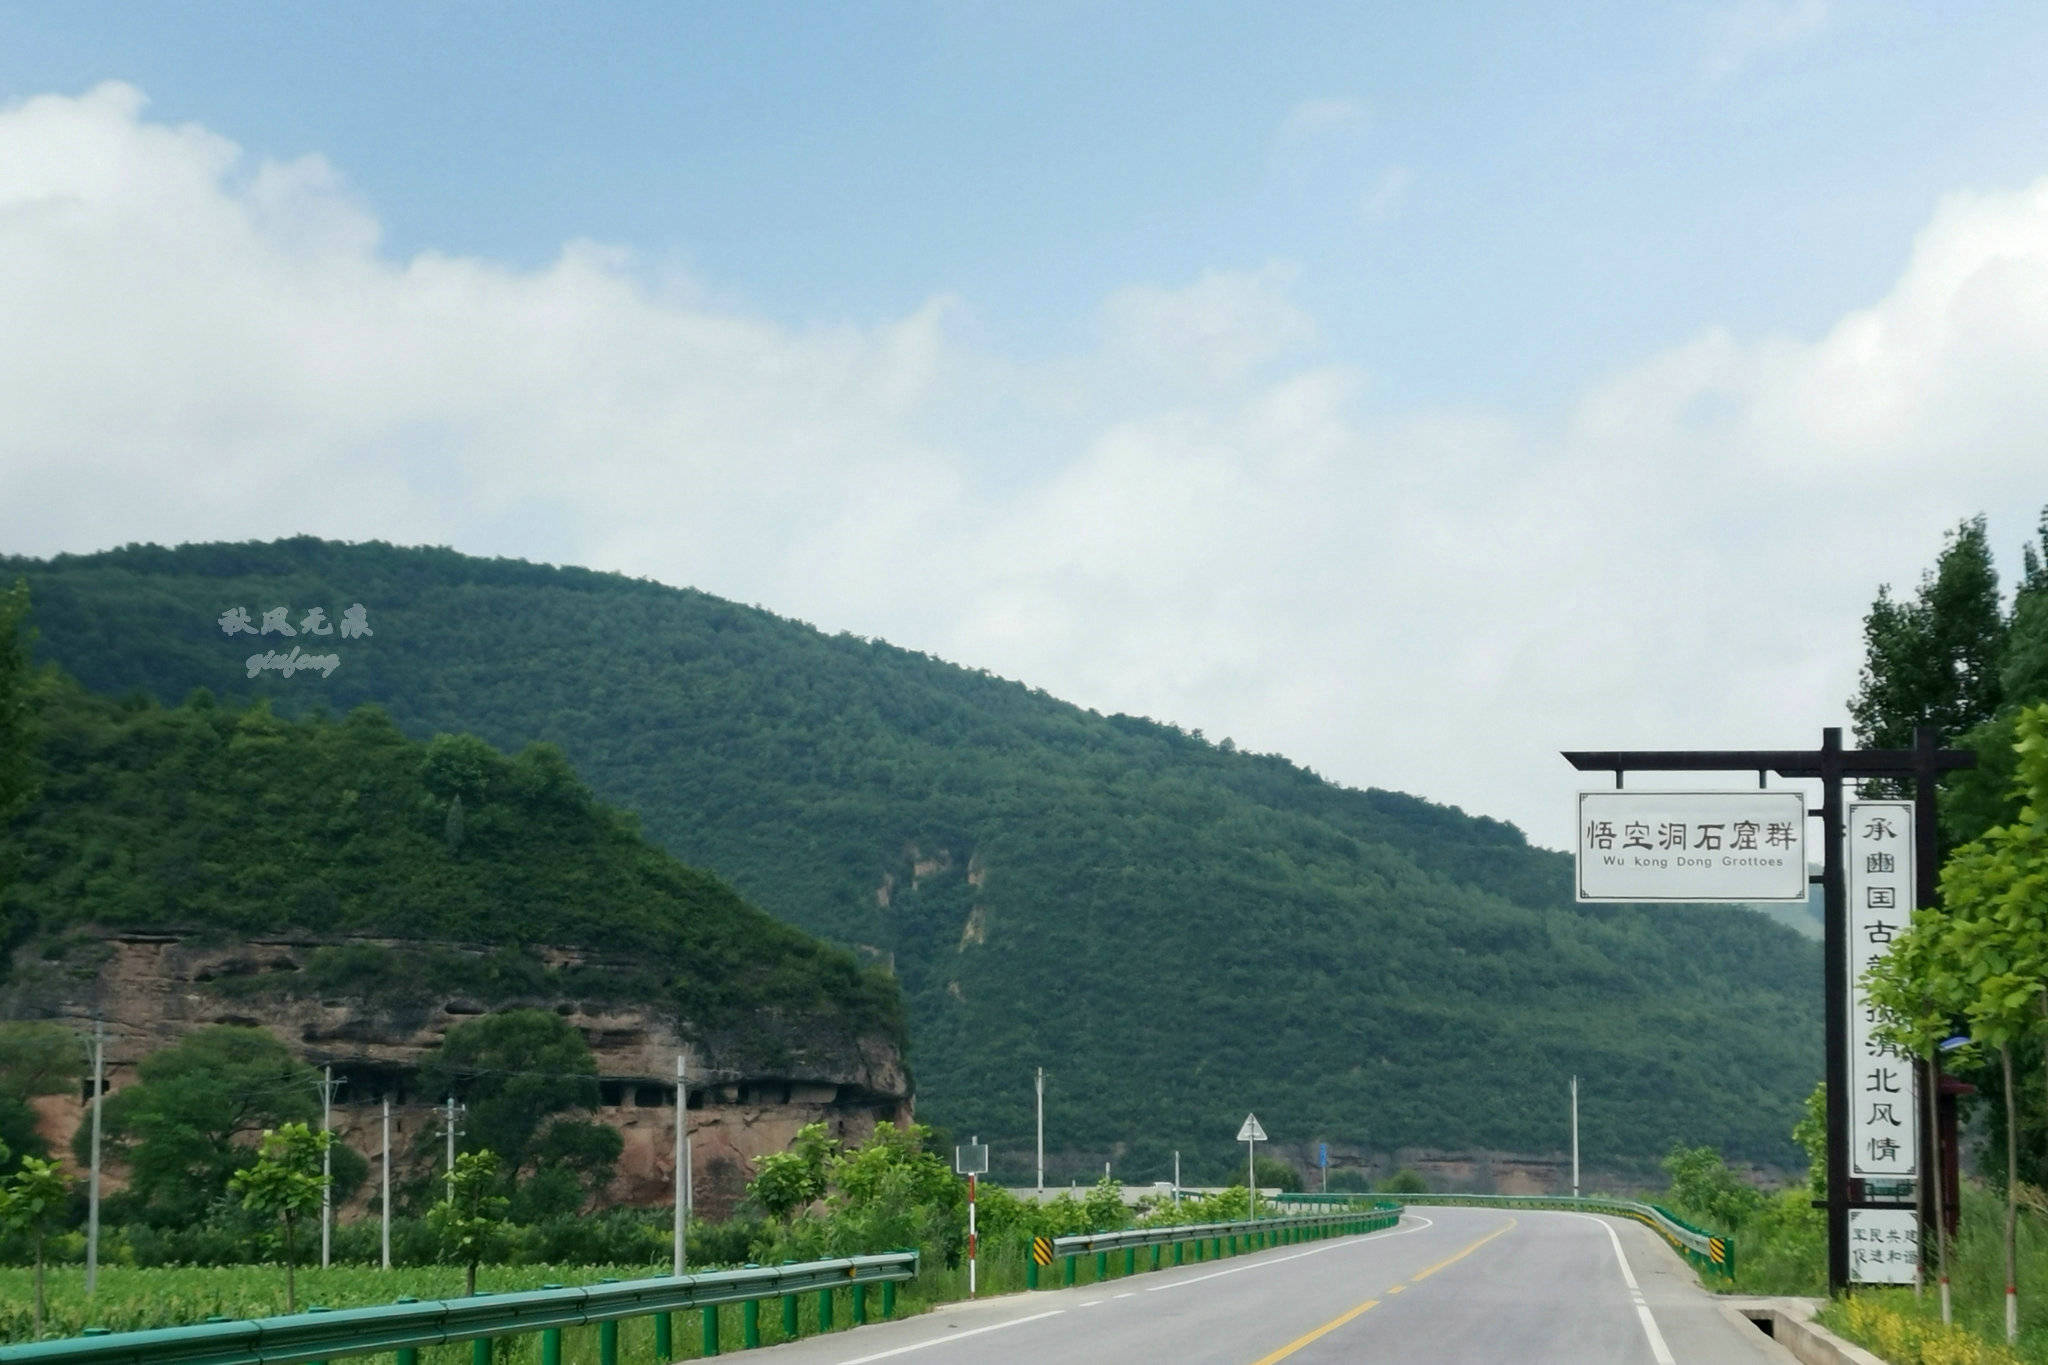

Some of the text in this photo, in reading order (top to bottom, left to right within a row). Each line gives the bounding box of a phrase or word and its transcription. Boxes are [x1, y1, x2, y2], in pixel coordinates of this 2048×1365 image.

[1587, 820, 1798, 851] 悟空洞石窟群
[1603, 856, 1625, 866] Wu
[1677, 857, 1712, 869] Dong
[1722, 857, 1784, 867] Grottoes
